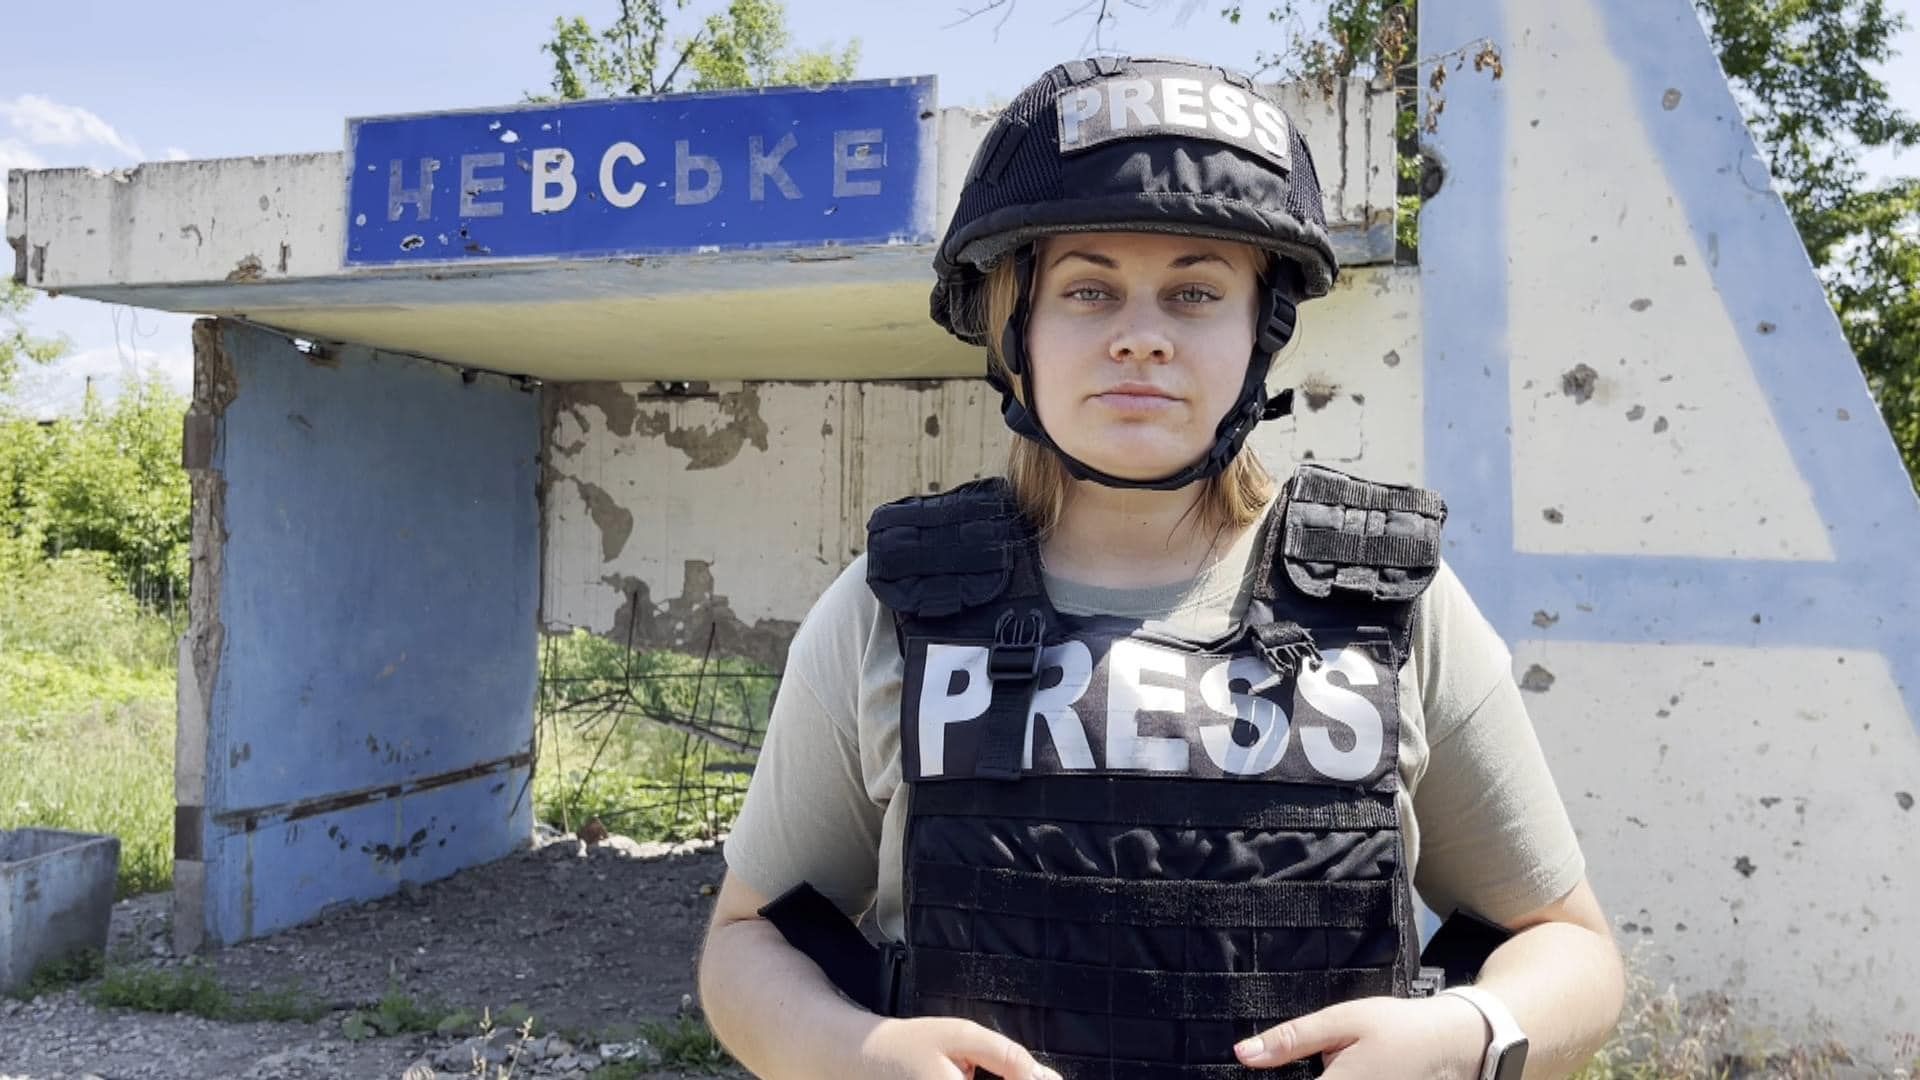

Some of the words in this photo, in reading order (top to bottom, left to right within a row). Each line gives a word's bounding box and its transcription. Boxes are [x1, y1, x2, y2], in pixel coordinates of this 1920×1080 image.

[1062, 77, 1288, 158] PRESS
[388, 129, 884, 222] НЕВСЬКЕ
[918, 639, 1384, 781] PRESS
